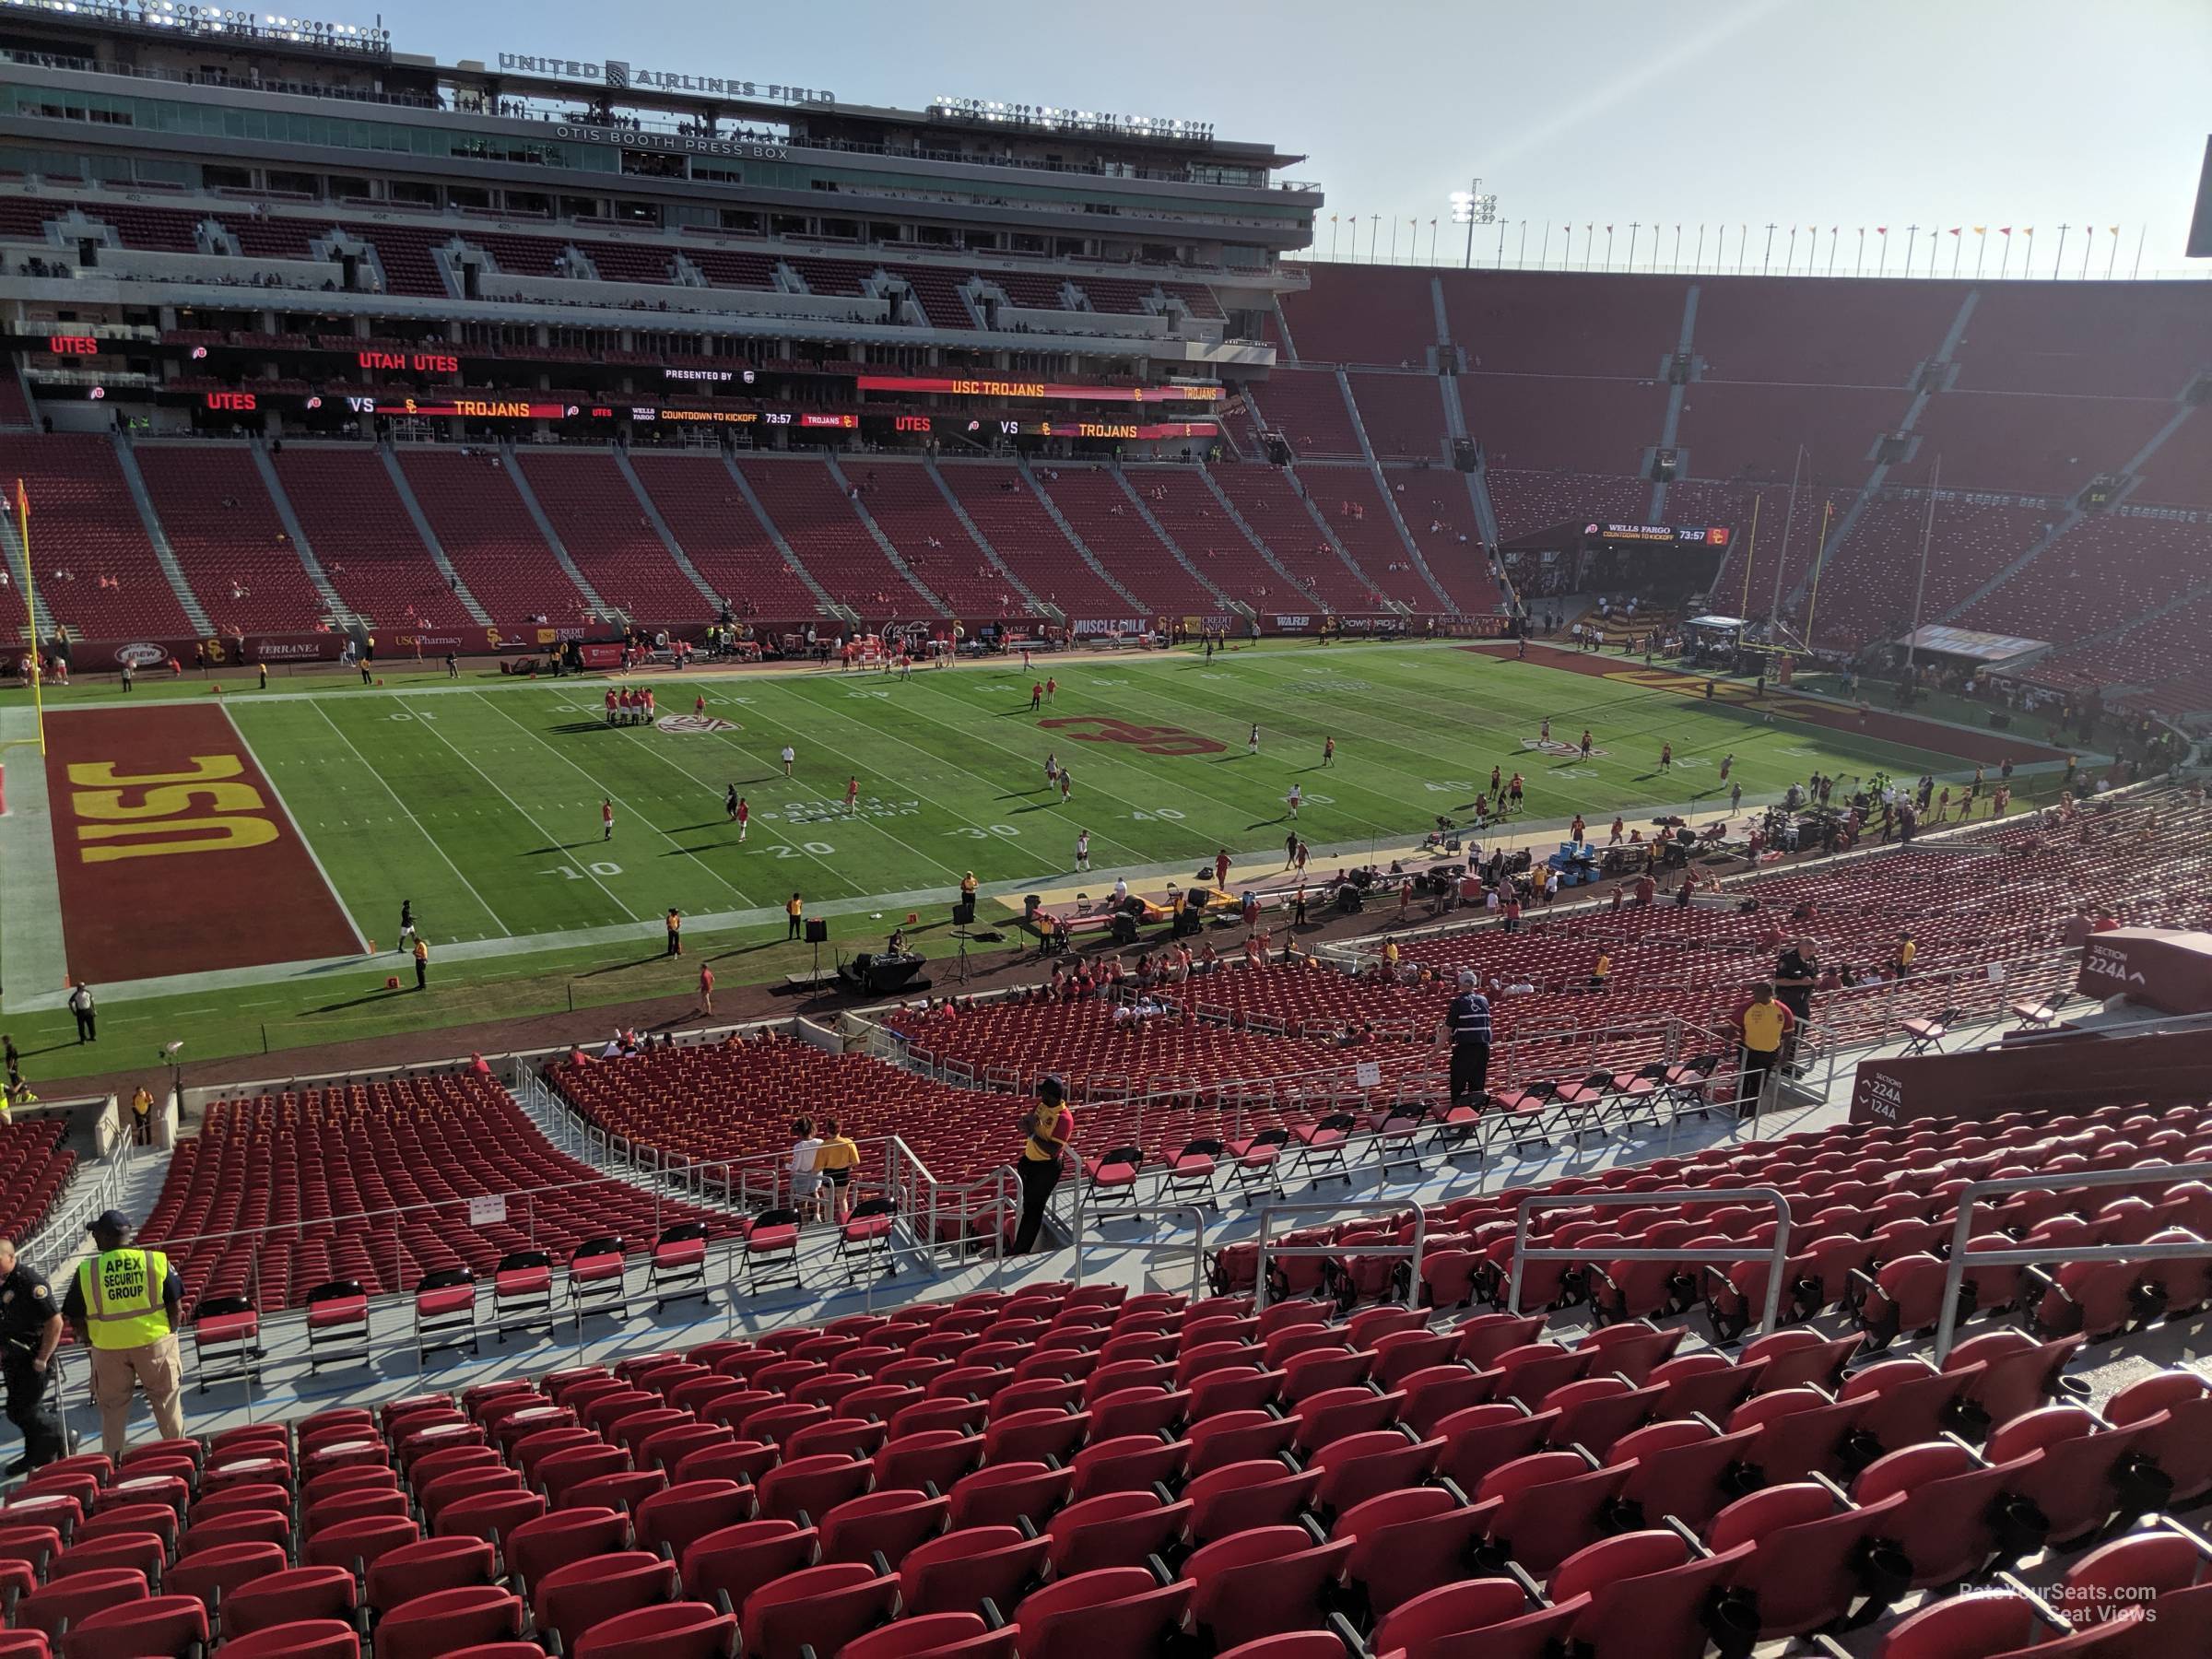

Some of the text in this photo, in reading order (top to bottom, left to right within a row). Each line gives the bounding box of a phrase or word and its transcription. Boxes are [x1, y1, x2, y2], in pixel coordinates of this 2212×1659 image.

[499, 53, 836, 105] UNITED AIRLINES FIELD
[557, 126, 789, 160] OTIS BOOTH PRESS BOX
[52, 337, 98, 354] UTES
[359, 352, 457, 371] UTAH UTES
[665, 370, 733, 381] PRESENTED BY
[952, 381, 1044, 397] USC TROJANS
[1183, 387, 1217, 400] TROJANS
[208, 393, 256, 409] UTES
[349, 398, 374, 412] VS
[455, 401, 530, 417] TROJANS
[593, 408, 612, 417] UTES
[662, 410, 791, 424] COUNTDOWN TO KICKOFF 73:57
[807, 417, 840, 425] TROJANS
[896, 418, 930, 431] UTES
[1000, 421, 1018, 434] VS
[1079, 423, 1137, 438] TROJANS
[1603, 531, 1640, 539] COUNTDOWN
[1650, 533, 1674, 541] KICKOFF
[1609, 524, 1670, 534] WELLS FARGO
[1679, 531, 1705, 540] 73:57
[1075, 619, 1115, 634] MUSCLE
[1277, 616, 1310, 627] WARE
[557, 628, 585, 636] CREDIT
[417, 635, 463, 646] Pharmacy
[257, 643, 321, 654] TERRANEA
[709, 697, 758, 705] 30
[389, 712, 438, 722] 10
[1425, 781, 1473, 792] 40
[67, 754, 280, 863] USC
[1133, 808, 1186, 822] 40
[959, 824, 1021, 839] 30
[765, 841, 836, 859] 20
[556, 862, 624, 879] 10
[2092, 944, 2128, 961] SECTION
[2087, 956, 2127, 982] 224A
[1876, 1072, 1902, 1088] SECTIONS
[1872, 1081, 1901, 1103] 224A
[1870, 1098, 1897, 1121] 124A
[106, 1257, 142, 1273] APEX
[104, 1271, 144, 1288] SECURITY
[108, 1287, 144, 1300] GROUP
